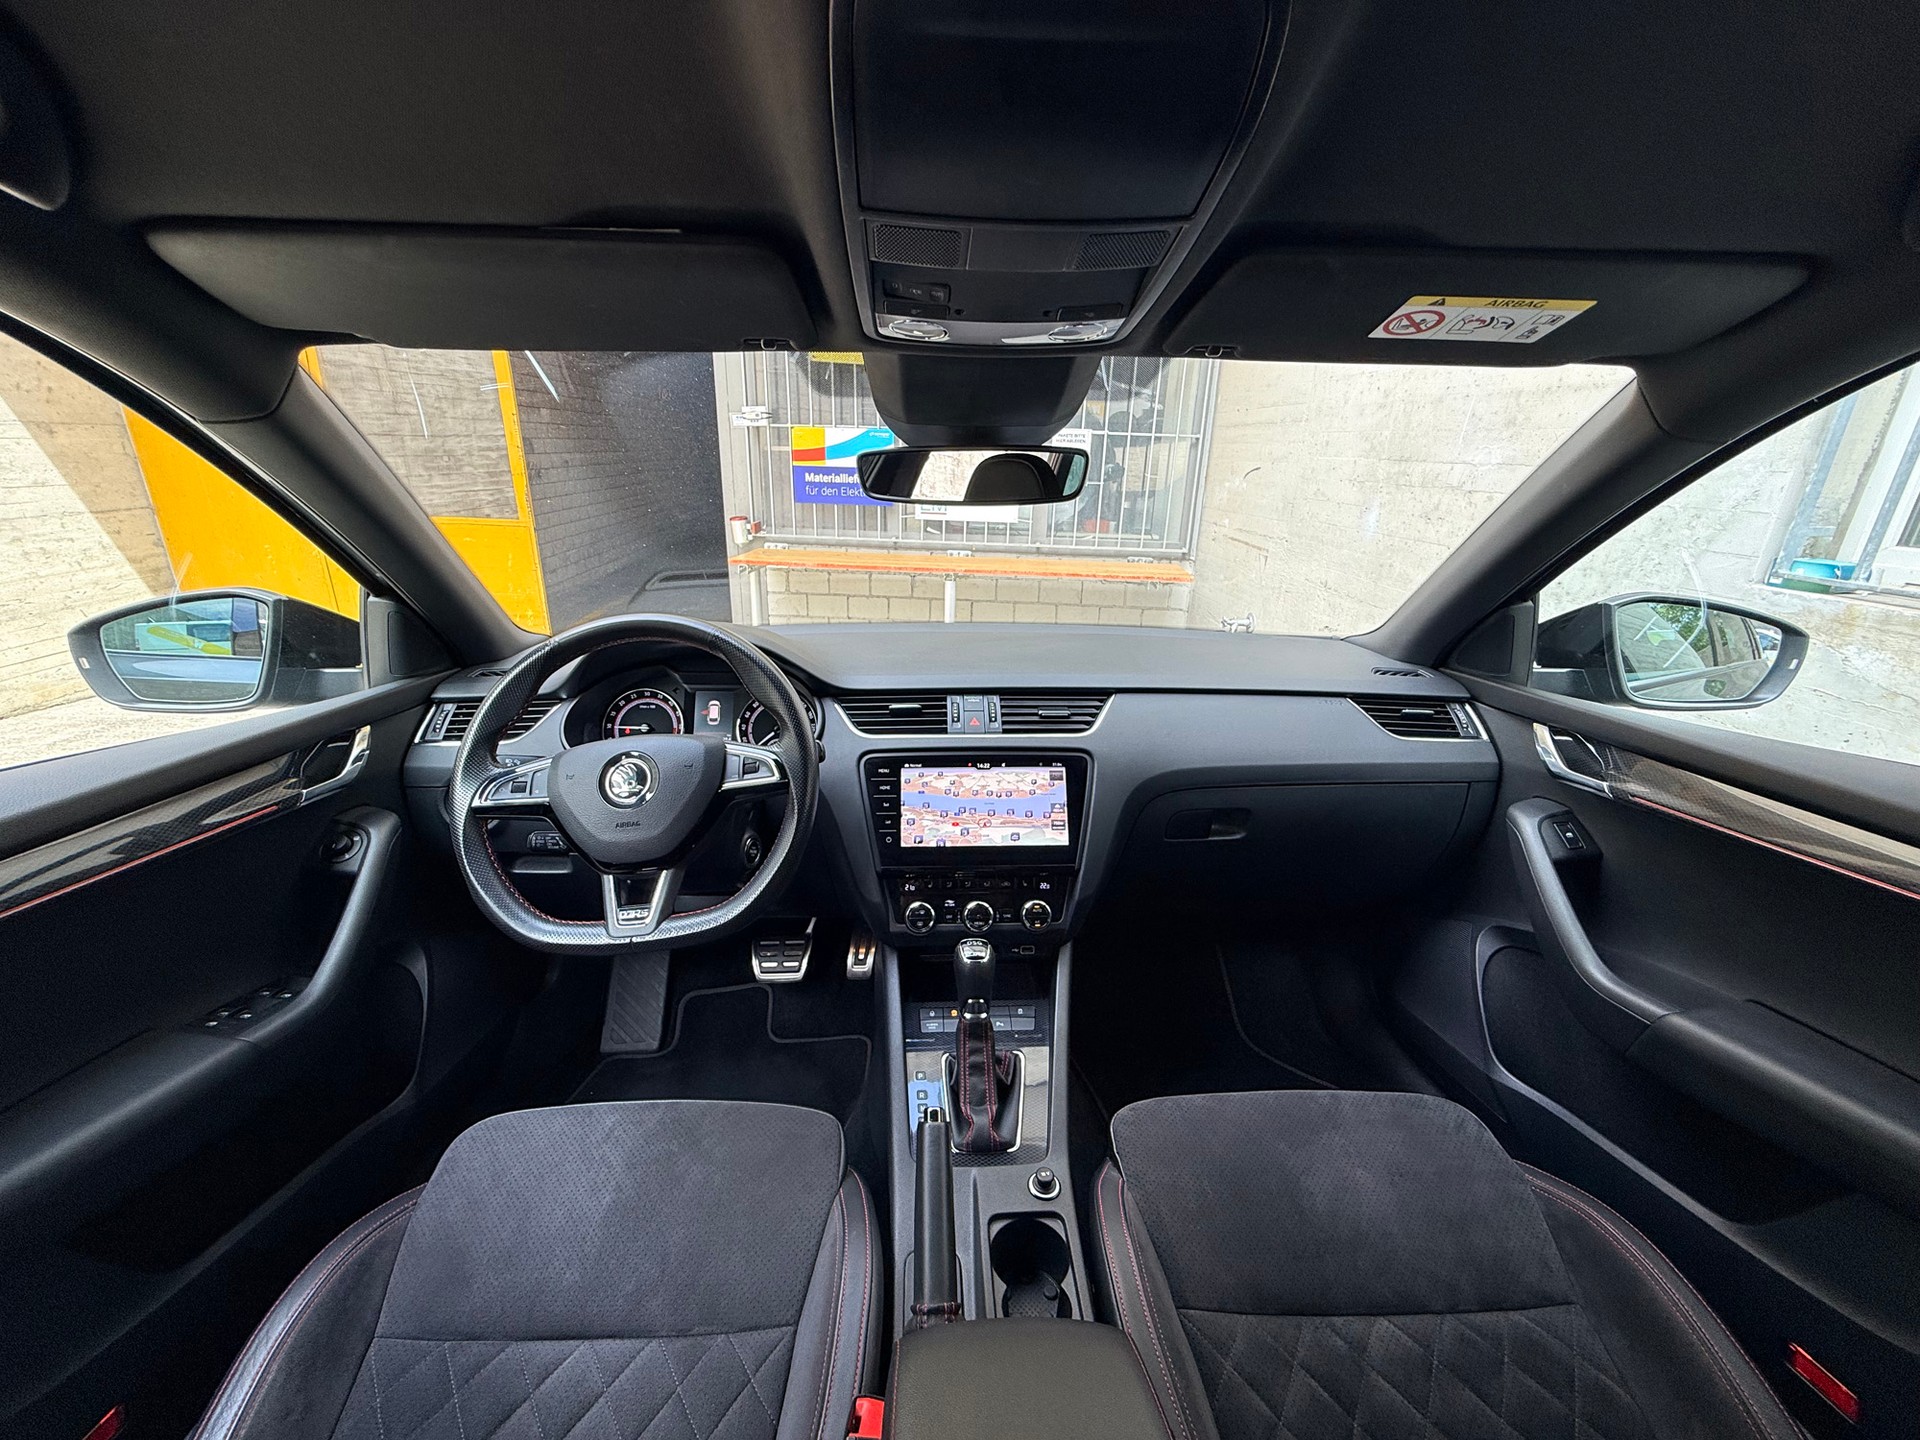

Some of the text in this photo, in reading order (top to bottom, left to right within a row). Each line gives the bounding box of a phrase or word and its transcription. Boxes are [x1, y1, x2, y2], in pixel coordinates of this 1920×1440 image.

[1484, 300, 1549, 308] AIRBAG
[805, 485, 818, 495] für
[821, 487, 838, 496] den
